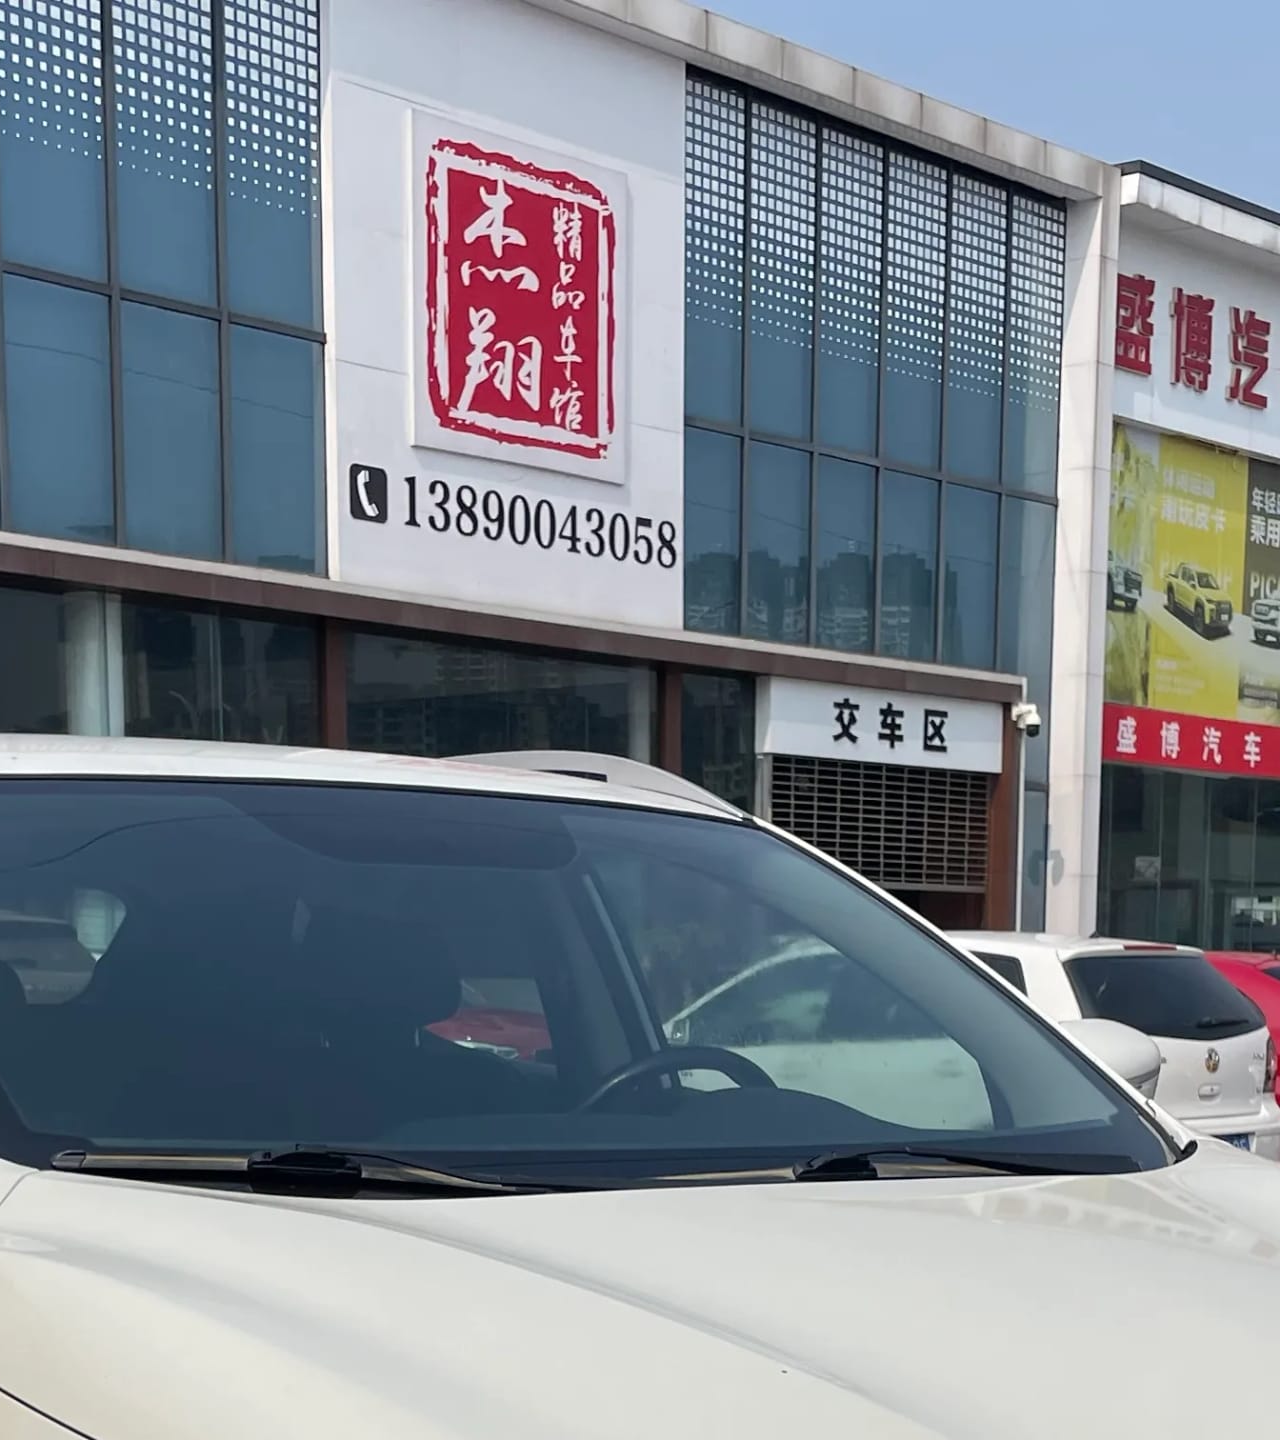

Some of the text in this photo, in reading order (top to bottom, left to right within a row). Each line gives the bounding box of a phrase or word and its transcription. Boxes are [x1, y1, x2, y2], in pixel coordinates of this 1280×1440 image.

[456, 178, 543, 412] 杰翔
[549, 201, 586, 432] 精品车馆
[404, 474, 678, 569] 13890043058
[832, 698, 949, 752] 交车区
